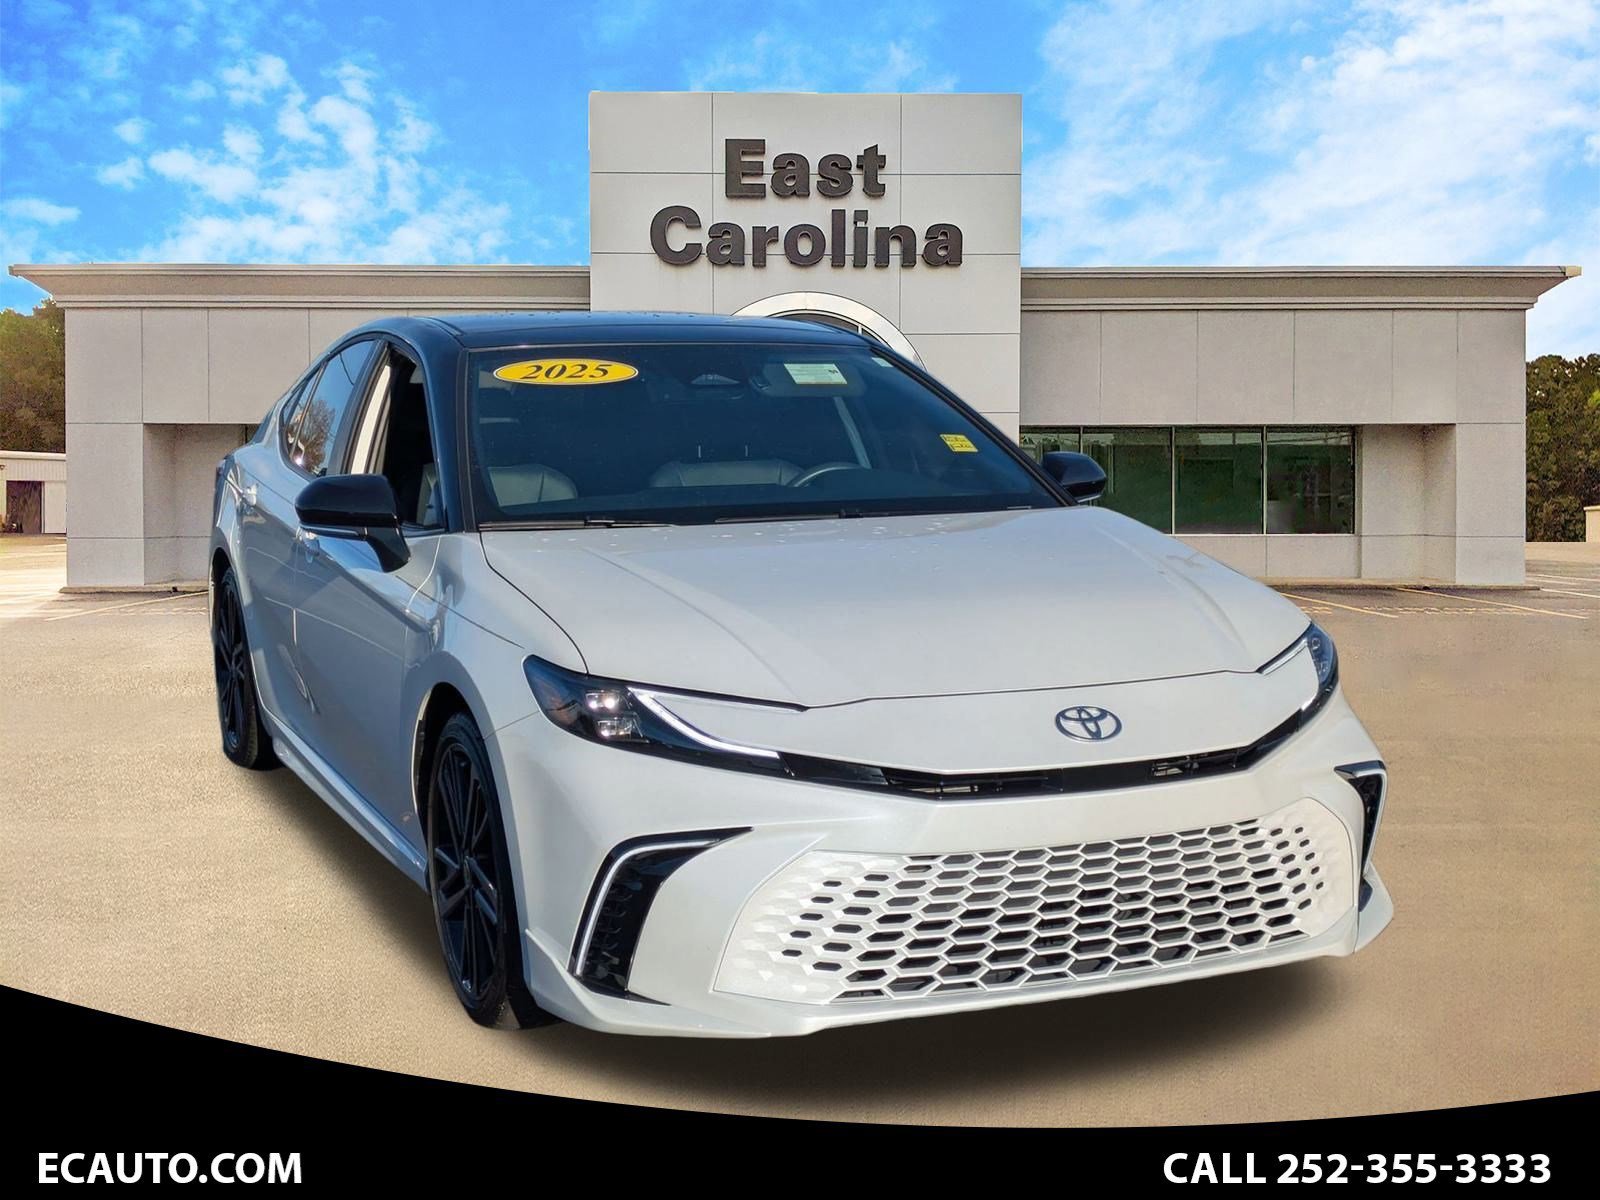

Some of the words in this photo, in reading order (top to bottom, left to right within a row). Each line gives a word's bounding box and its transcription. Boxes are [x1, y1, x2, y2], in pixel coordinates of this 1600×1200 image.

[724, 138, 887, 201] East
[650, 205, 964, 270] Carolina
[519, 363, 613, 380] 2025
